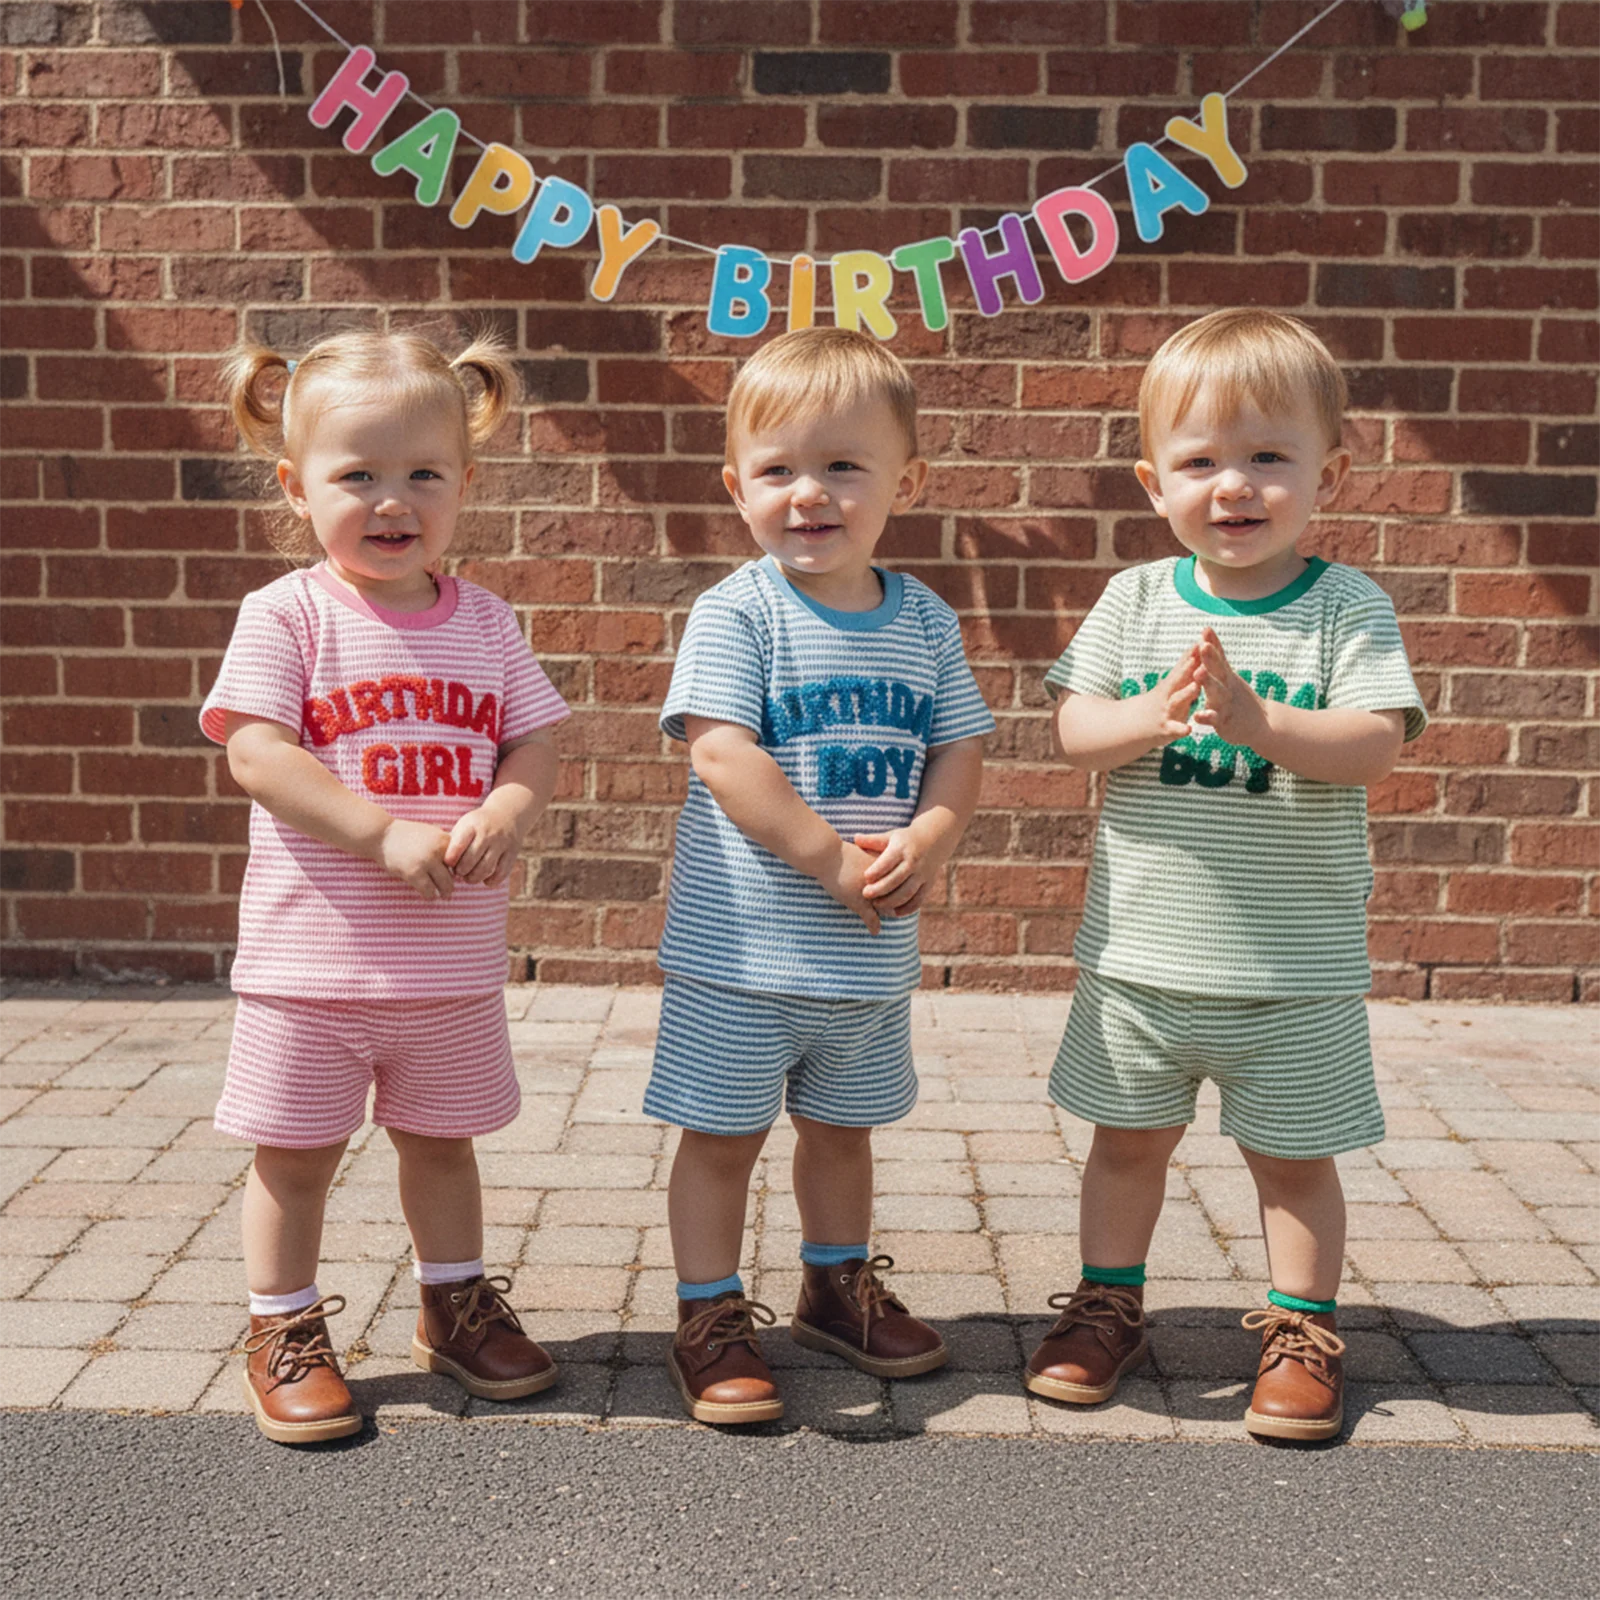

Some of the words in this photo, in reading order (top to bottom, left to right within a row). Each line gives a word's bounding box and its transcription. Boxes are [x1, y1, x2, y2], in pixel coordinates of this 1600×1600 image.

[308, 44, 661, 302] HAPPY
[706, 92, 1248, 340] BIRTHDAY
[303, 674, 504, 747] BIRTHDA
[362, 743, 484, 797] GIRL
[817, 745, 916, 799] BOY
